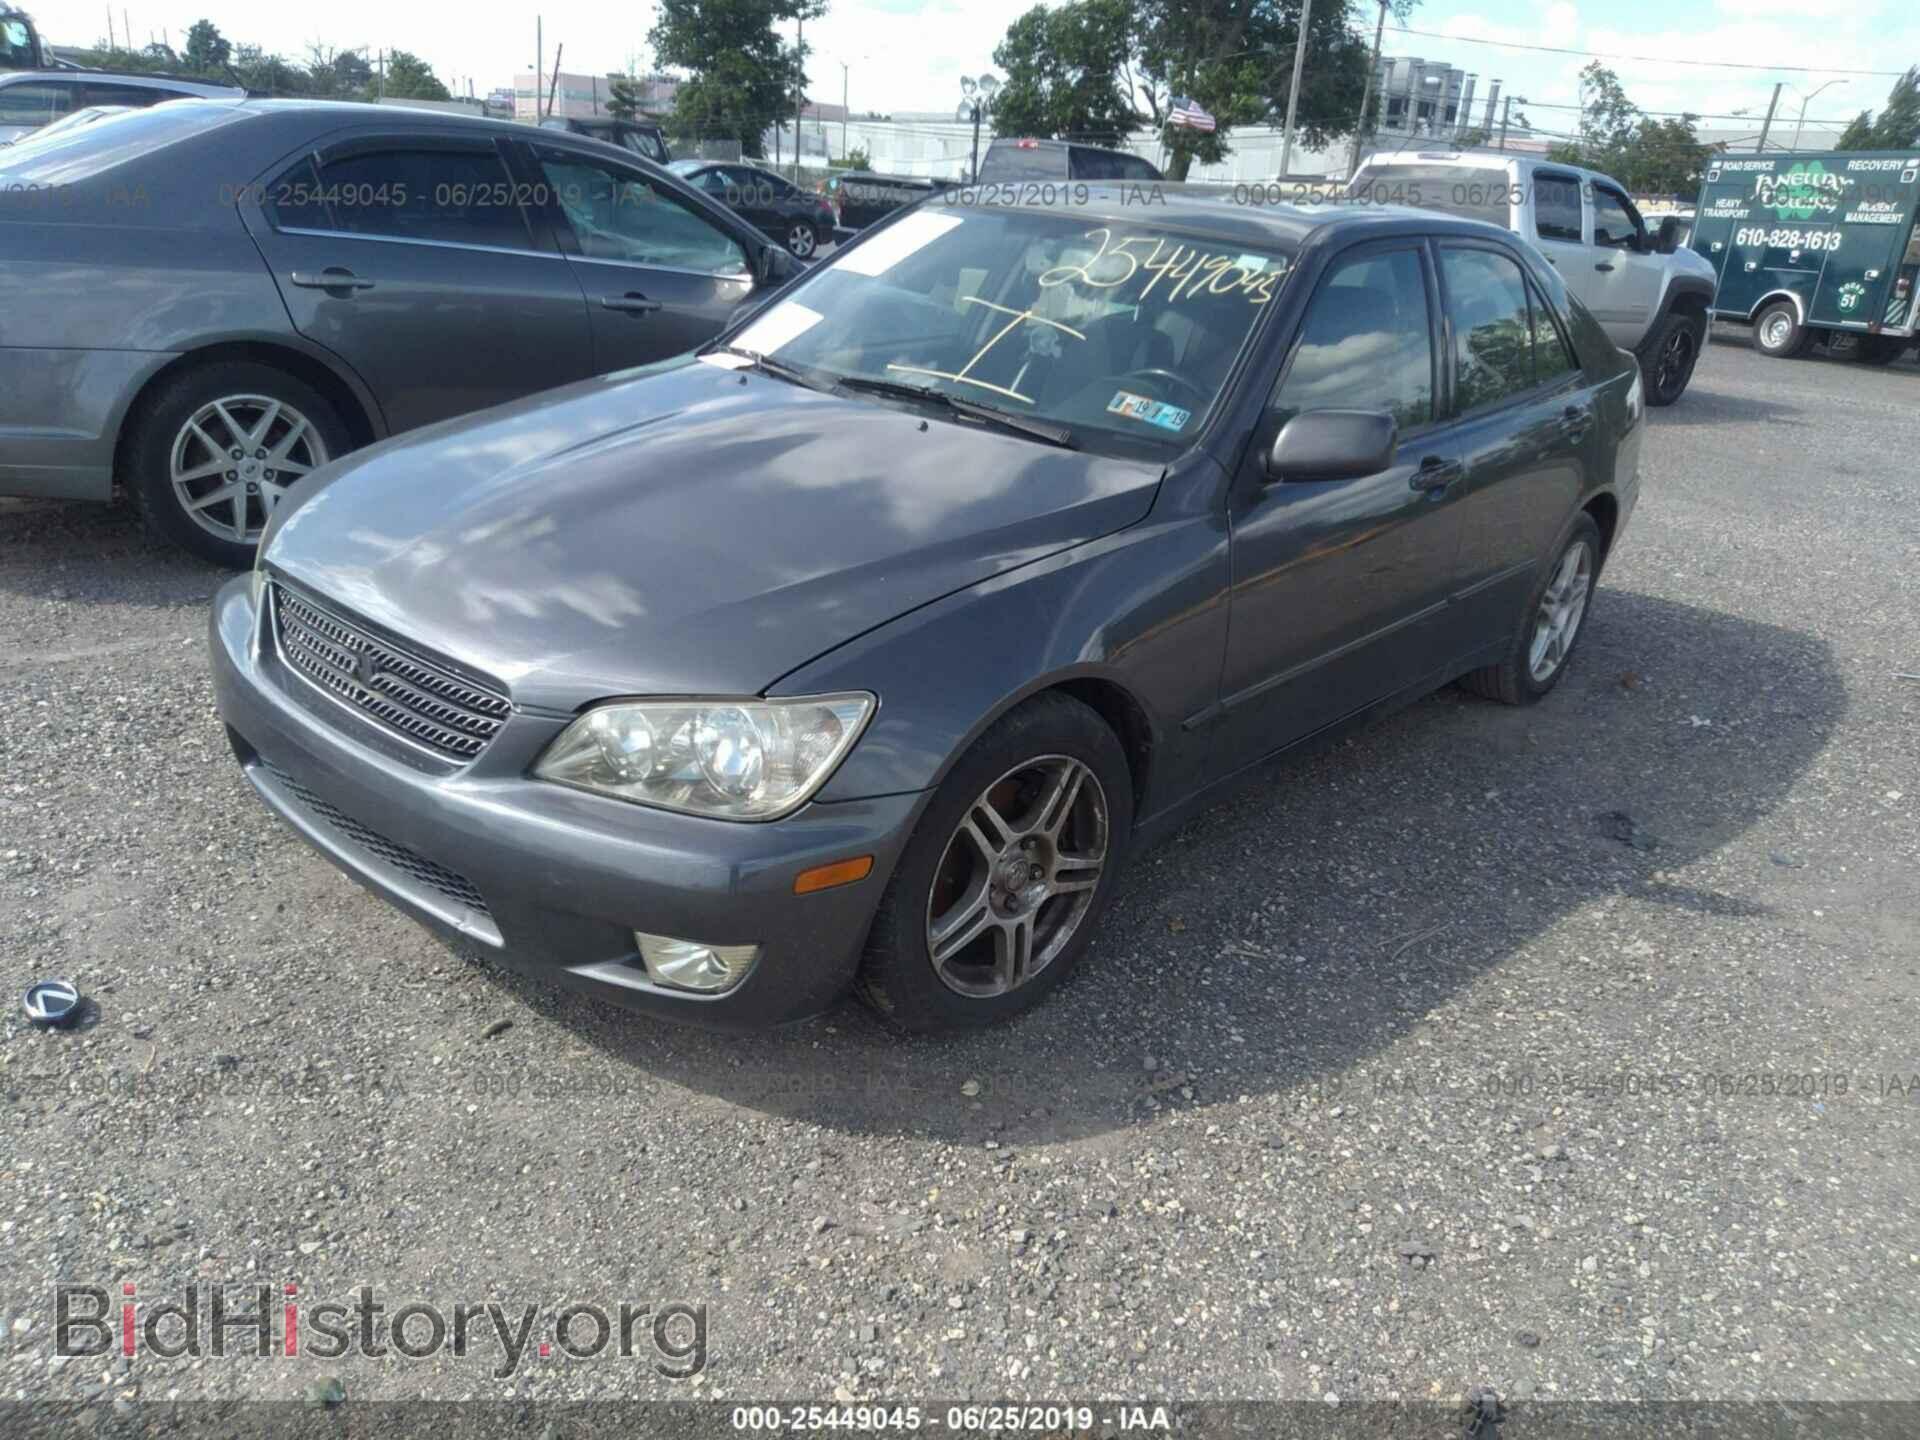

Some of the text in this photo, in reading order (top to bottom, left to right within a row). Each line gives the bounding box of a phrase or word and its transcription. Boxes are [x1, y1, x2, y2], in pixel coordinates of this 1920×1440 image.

[1722, 161, 1776, 171] ROAD SERVICE
[1847, 160, 1904, 171] RECOVERY
[1714, 199, 1742, 209] HEAVY
[1703, 208, 1750, 219] TRANSPORT
[1844, 211, 1904, 225] MANAGEMENT
[1736, 228, 1842, 250] 610-828-1613
[1039, 228, 1287, 303] 25449045
